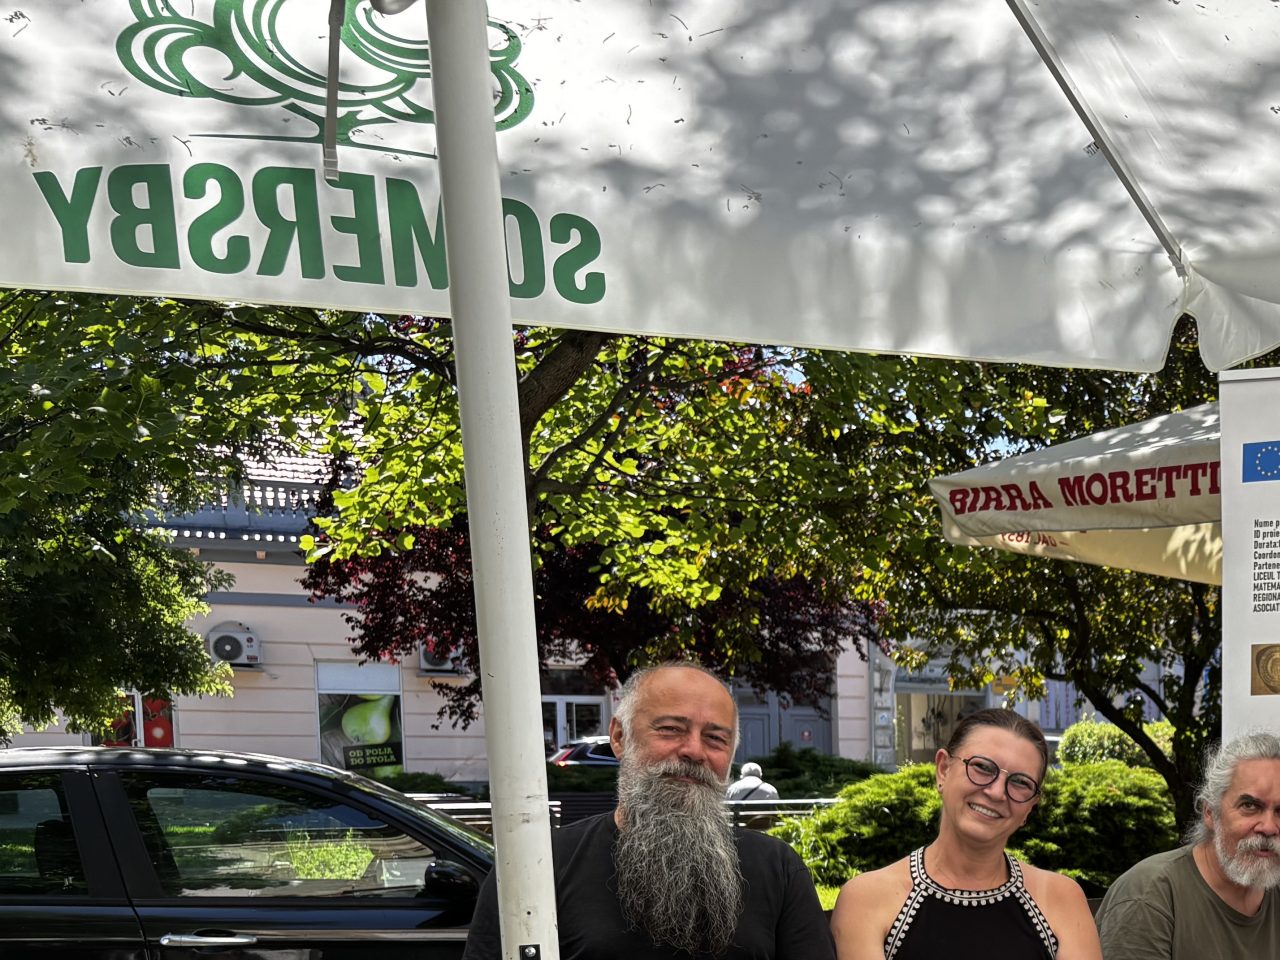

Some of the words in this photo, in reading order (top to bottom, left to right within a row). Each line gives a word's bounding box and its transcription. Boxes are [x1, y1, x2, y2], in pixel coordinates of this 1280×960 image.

[949, 480, 1054, 515] BIRRA
[1058, 461, 1220, 507] MORETTI
[1254, 519, 1273, 528] Nume
[1254, 529, 1261, 538] ID
[1254, 571, 1275, 581] LICEUL
[349, 750, 363, 758] OD
[365, 747, 393, 756] POLJA
[351, 758, 364, 766] DO
[366, 755, 396, 764] STOLA
